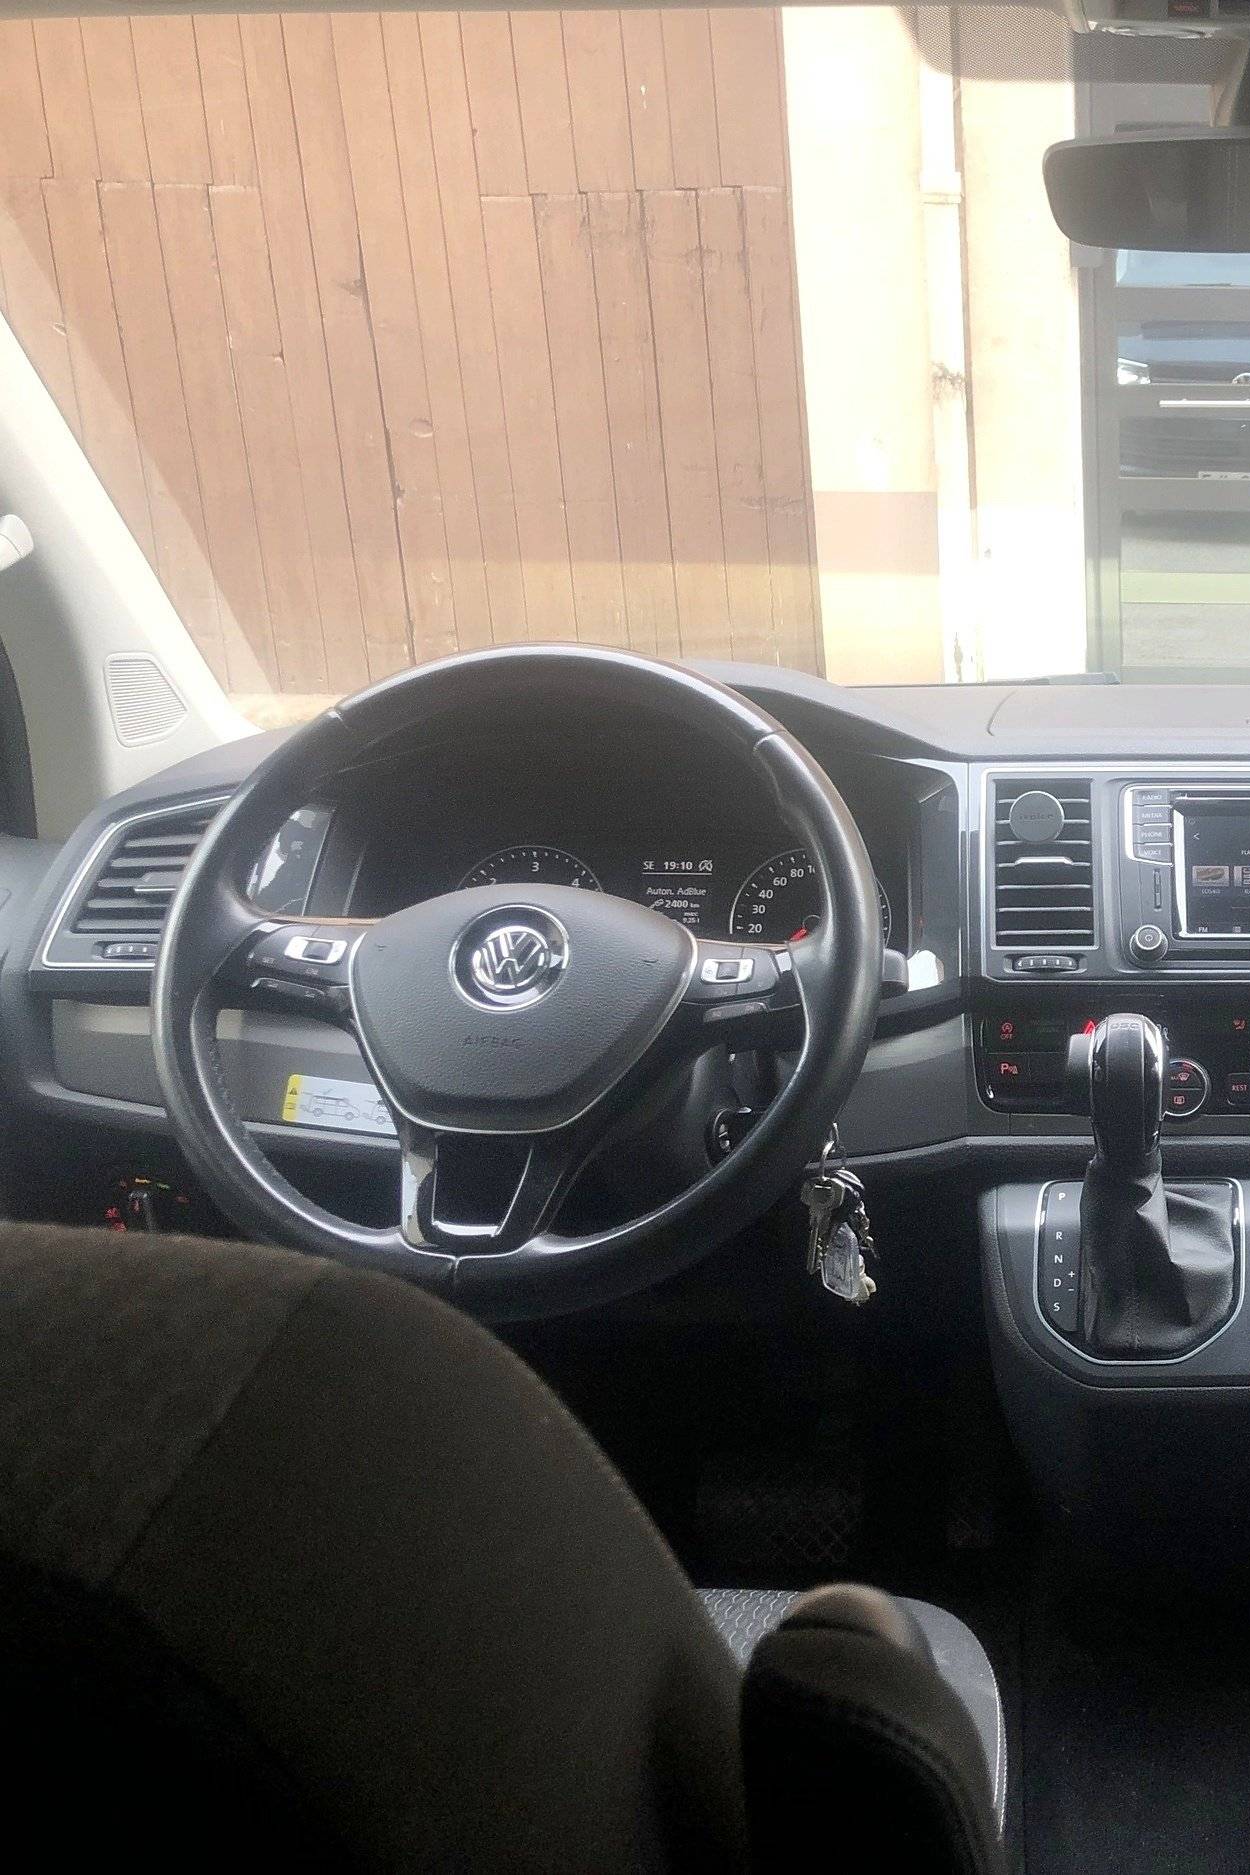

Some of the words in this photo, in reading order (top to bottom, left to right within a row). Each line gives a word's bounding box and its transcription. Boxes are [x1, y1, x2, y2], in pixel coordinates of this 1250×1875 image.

[531, 861, 540, 872] 3
[643, 861, 655, 870] SE
[663, 861, 693, 870] 19:10
[790, 868, 805, 878] 80
[571, 878, 580, 888] 4
[773, 876, 788, 886] 60
[677, 887, 707, 896] AdBlue
[758, 889, 774, 899] 40
[664, 900, 689, 909] 2400
[751, 904, 766, 914] 30
[748, 923, 763, 934] 20
[1231, 1084, 1248, 1092] REST
[1058, 1192, 1066, 1201] P
[1055, 1232, 1063, 1241] R
[1054, 1254, 1063, 1264] N
[1053, 1278, 1062, 1288] D
[1053, 1302, 1061, 1312] S
